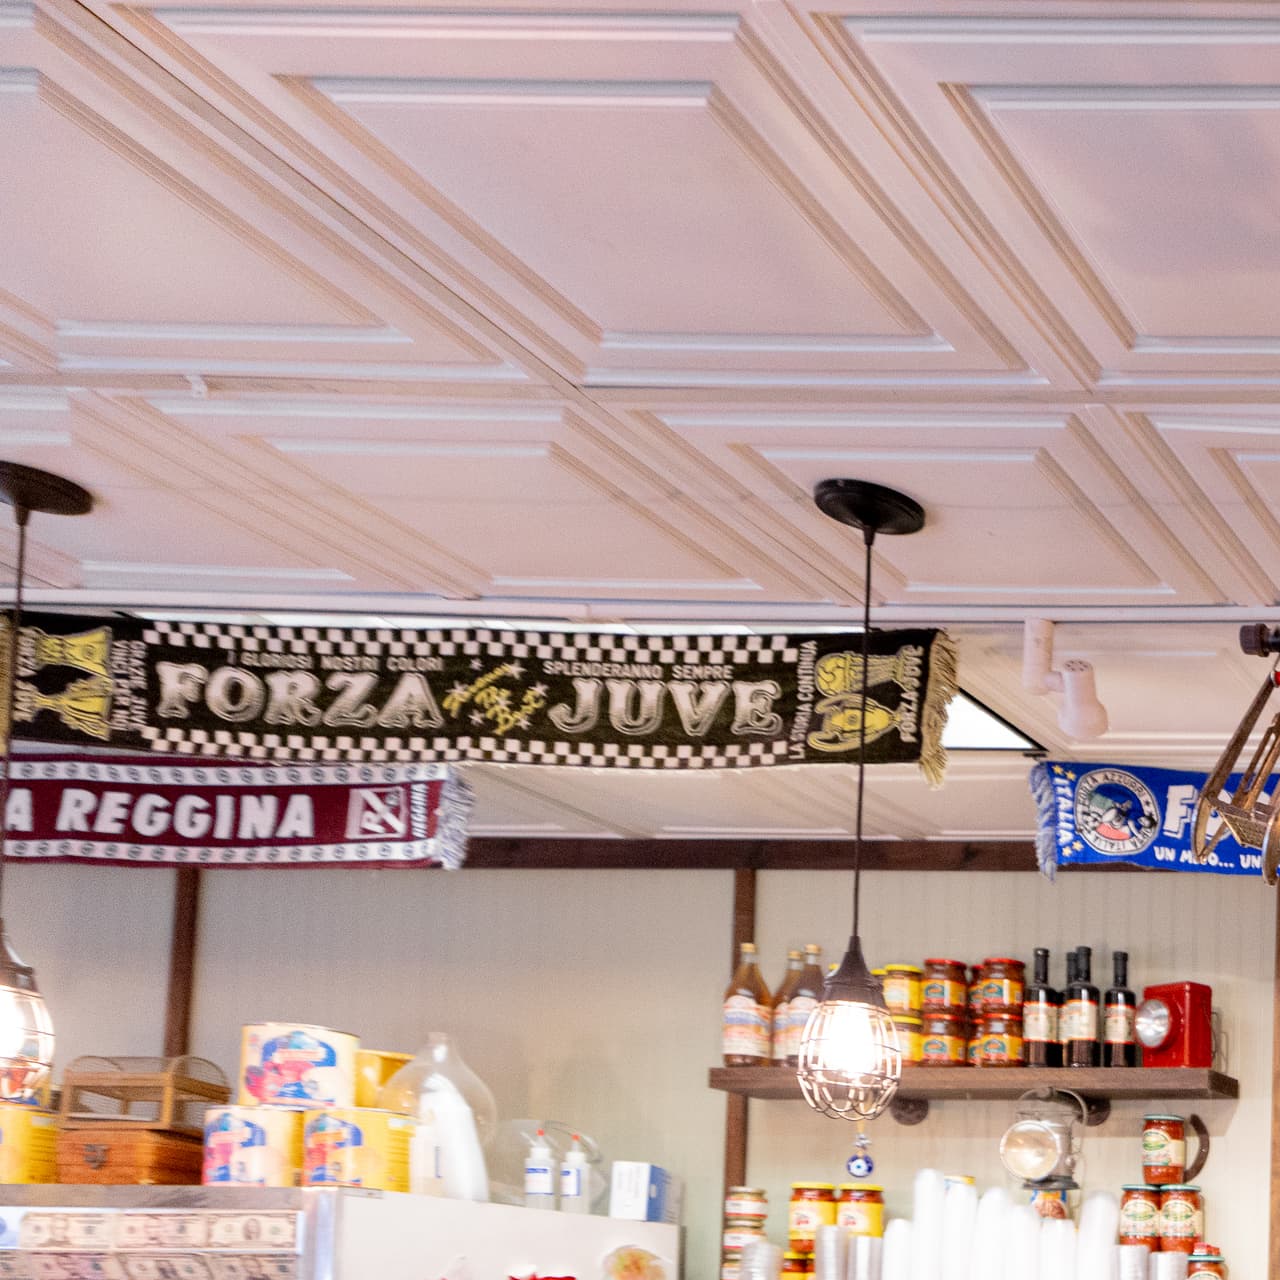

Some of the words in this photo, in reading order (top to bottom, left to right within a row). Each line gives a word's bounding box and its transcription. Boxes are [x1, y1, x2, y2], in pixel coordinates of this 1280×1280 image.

[321, 655, 379, 671] NOSTRI
[387, 656, 443, 671] COLORI
[543, 660, 663, 679] SPLENDERANNO
[671, 663, 733, 681] SEMPRE
[796, 640, 817, 702] CONTINUA
[156, 661, 446, 729] FORZA
[548, 677, 782, 738] JUVE
[789, 743, 805, 760] LA
[56, 788, 314, 840] REGGINA
[1053, 778, 1073, 846] ITALIA
[1153, 847, 1175, 861] UN
